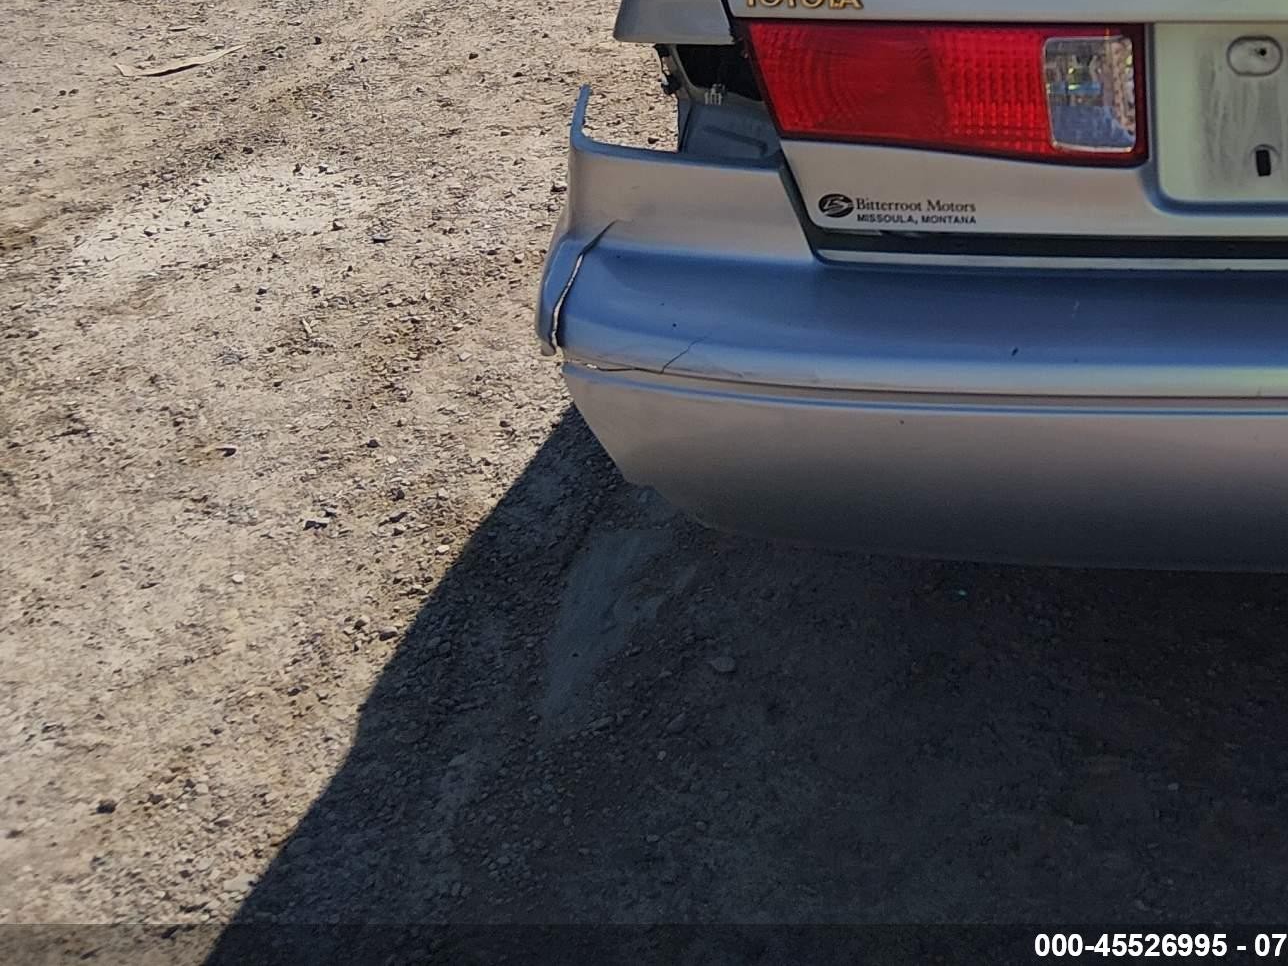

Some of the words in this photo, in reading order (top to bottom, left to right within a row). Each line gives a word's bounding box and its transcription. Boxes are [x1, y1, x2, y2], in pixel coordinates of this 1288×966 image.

[855, 198, 922, 212] Bitterroot
[926, 199, 976, 212] Motors
[857, 214, 918, 224] MISSOULA,
[921, 214, 977, 224] MONTANA
